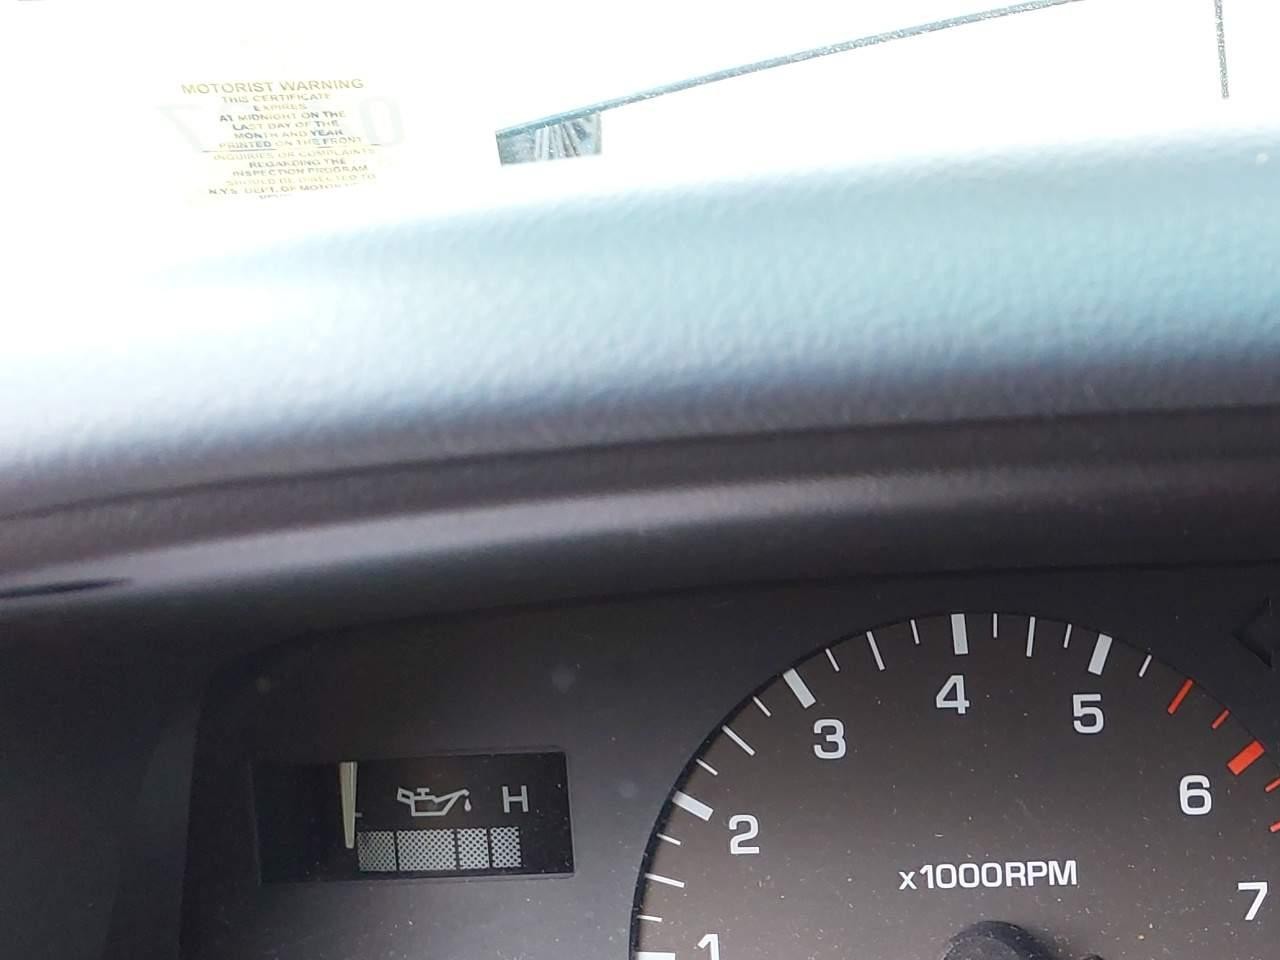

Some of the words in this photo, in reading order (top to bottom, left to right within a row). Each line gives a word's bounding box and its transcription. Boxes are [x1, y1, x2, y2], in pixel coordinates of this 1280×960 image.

[181, 82, 273, 94] MOTORIST
[280, 78, 364, 91] WARNING
[936, 675, 969, 713] 4
[1073, 694, 1103, 733] 5
[814, 719, 845, 759] 3
[502, 786, 528, 812] H
[1180, 775, 1211, 814] 6
[729, 815, 759, 854] 2
[1238, 882, 1267, 920] 7
